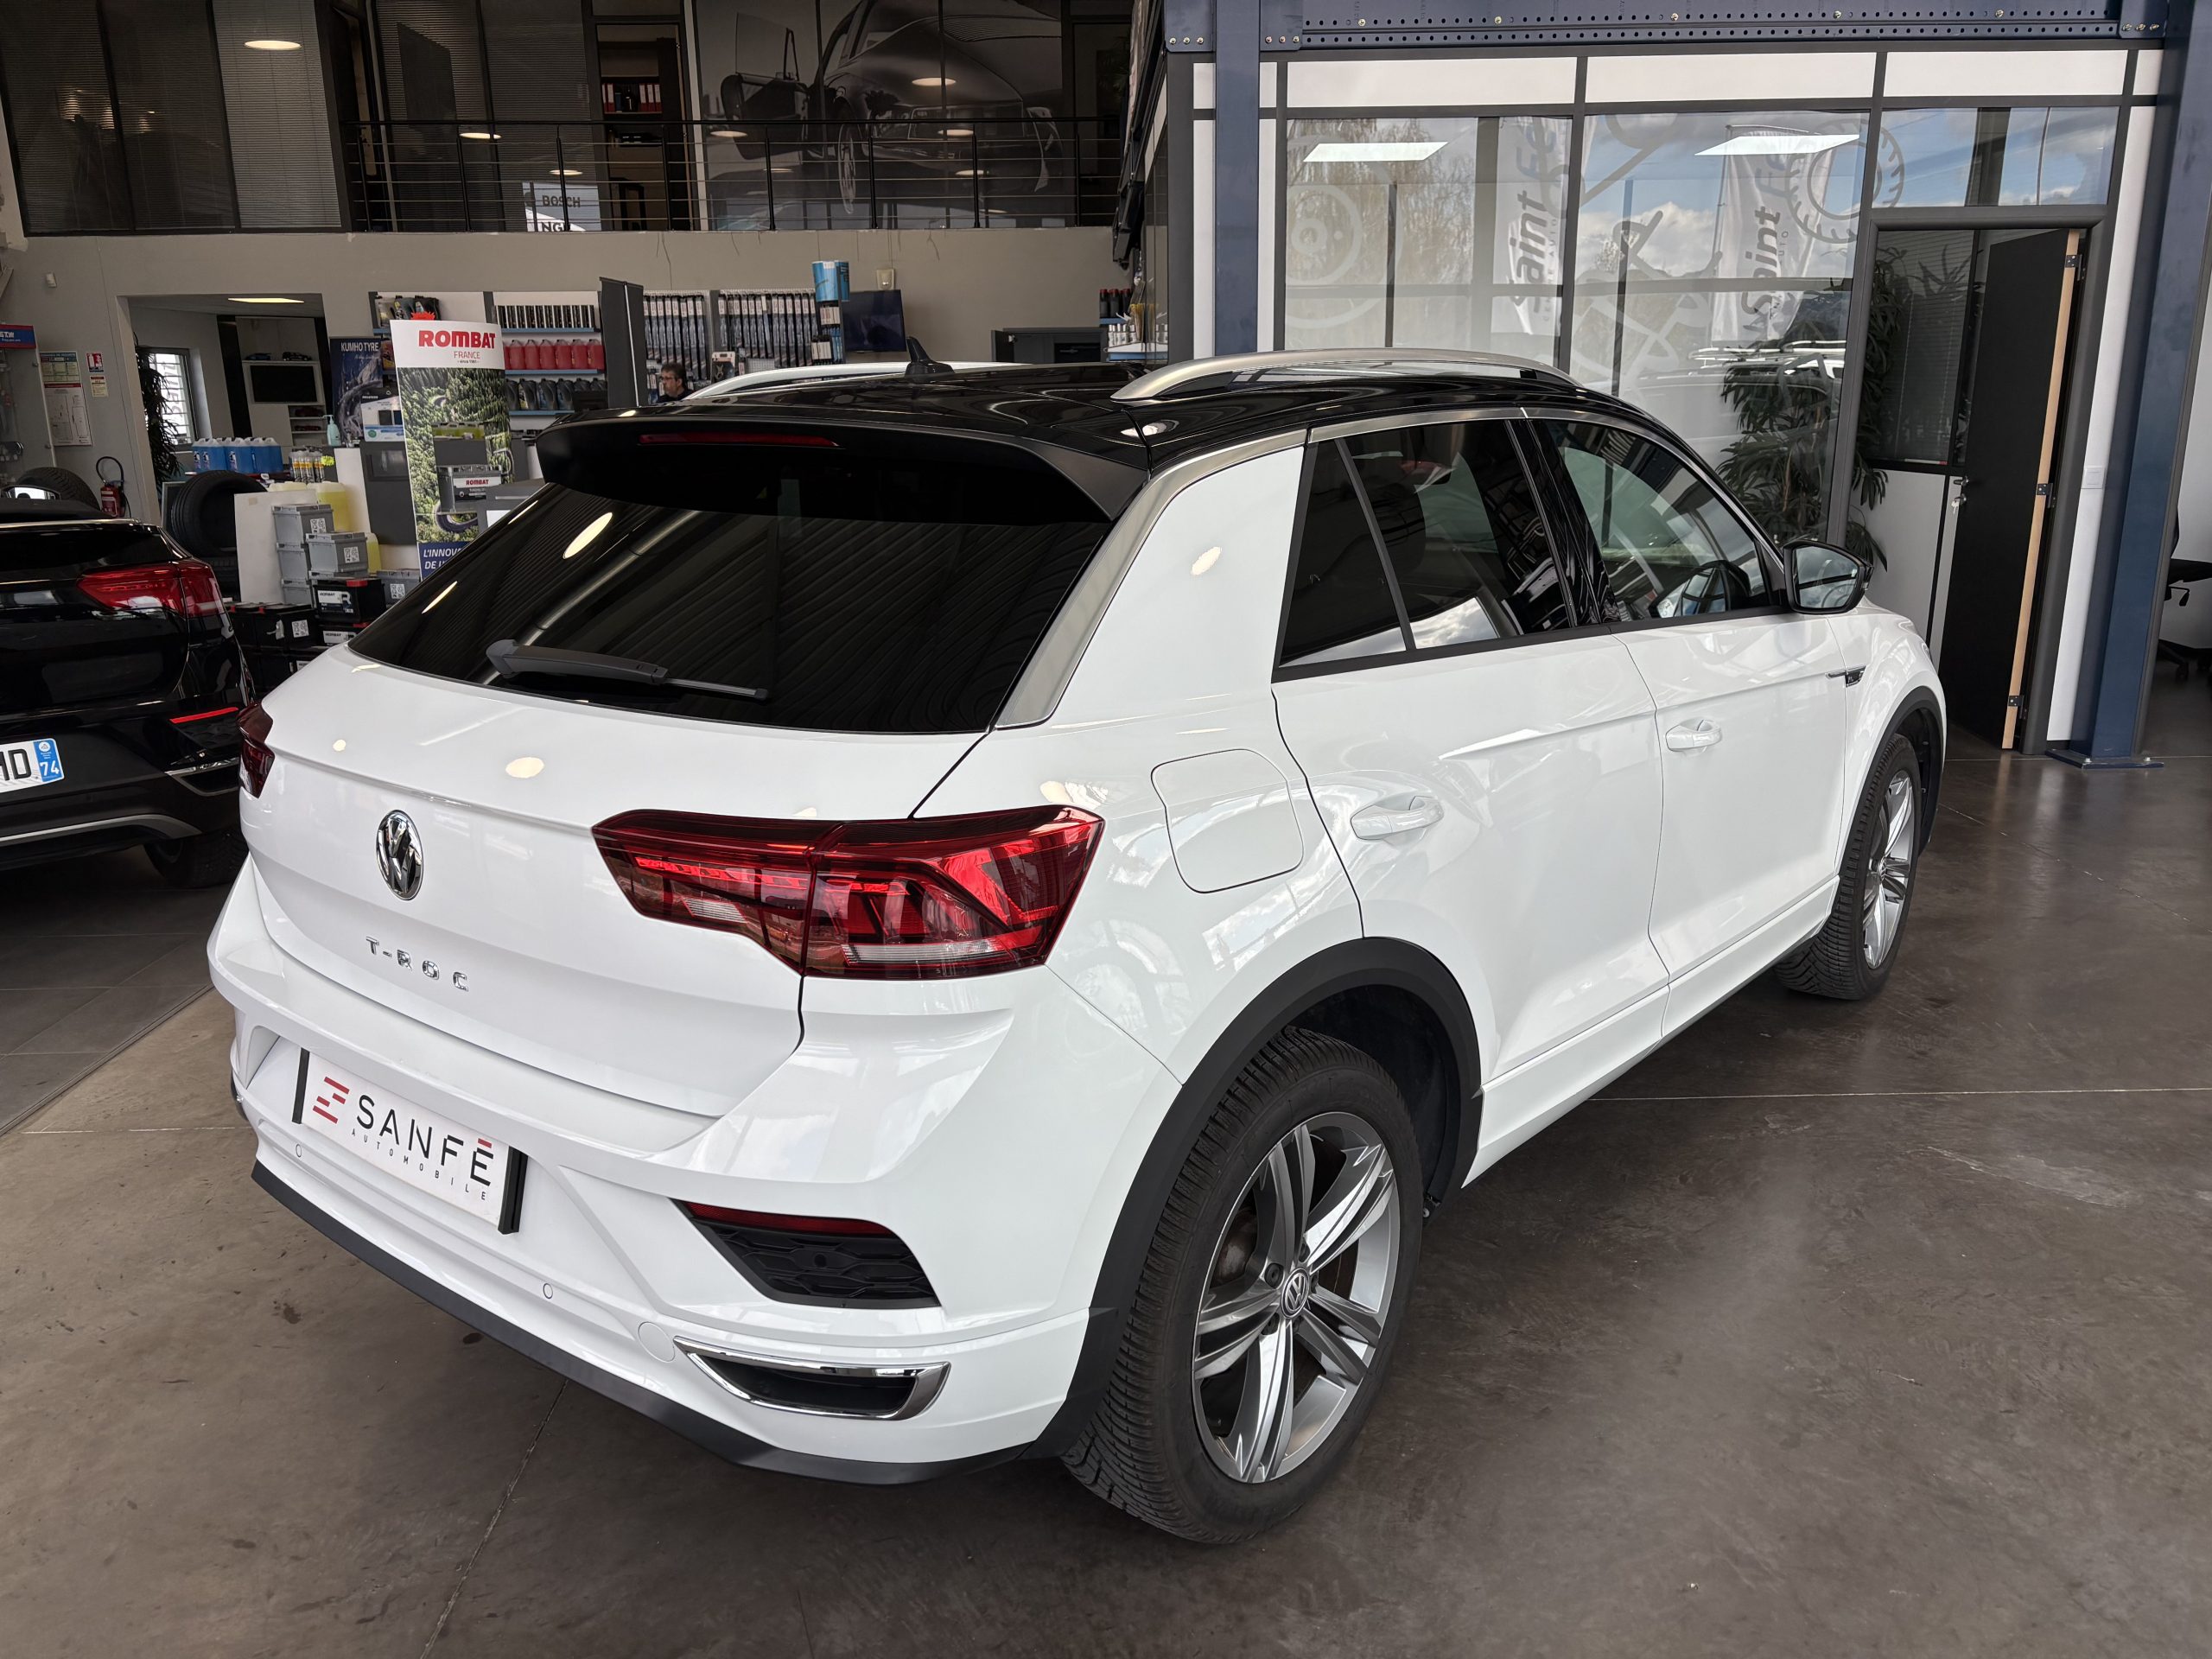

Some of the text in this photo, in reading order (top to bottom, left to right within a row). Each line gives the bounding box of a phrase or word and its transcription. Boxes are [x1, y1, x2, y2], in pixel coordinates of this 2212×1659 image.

[542, 194, 581, 207] BOSCH
[340, 342, 379, 353] KUMHO TYRE
[418, 330, 496, 349] ROMBAT
[425, 561, 436, 569] DE
[40, 760, 60, 776] 74
[365, 936, 469, 992] T-ROC
[352, 1128, 486, 1201] AUTOMOBILE
